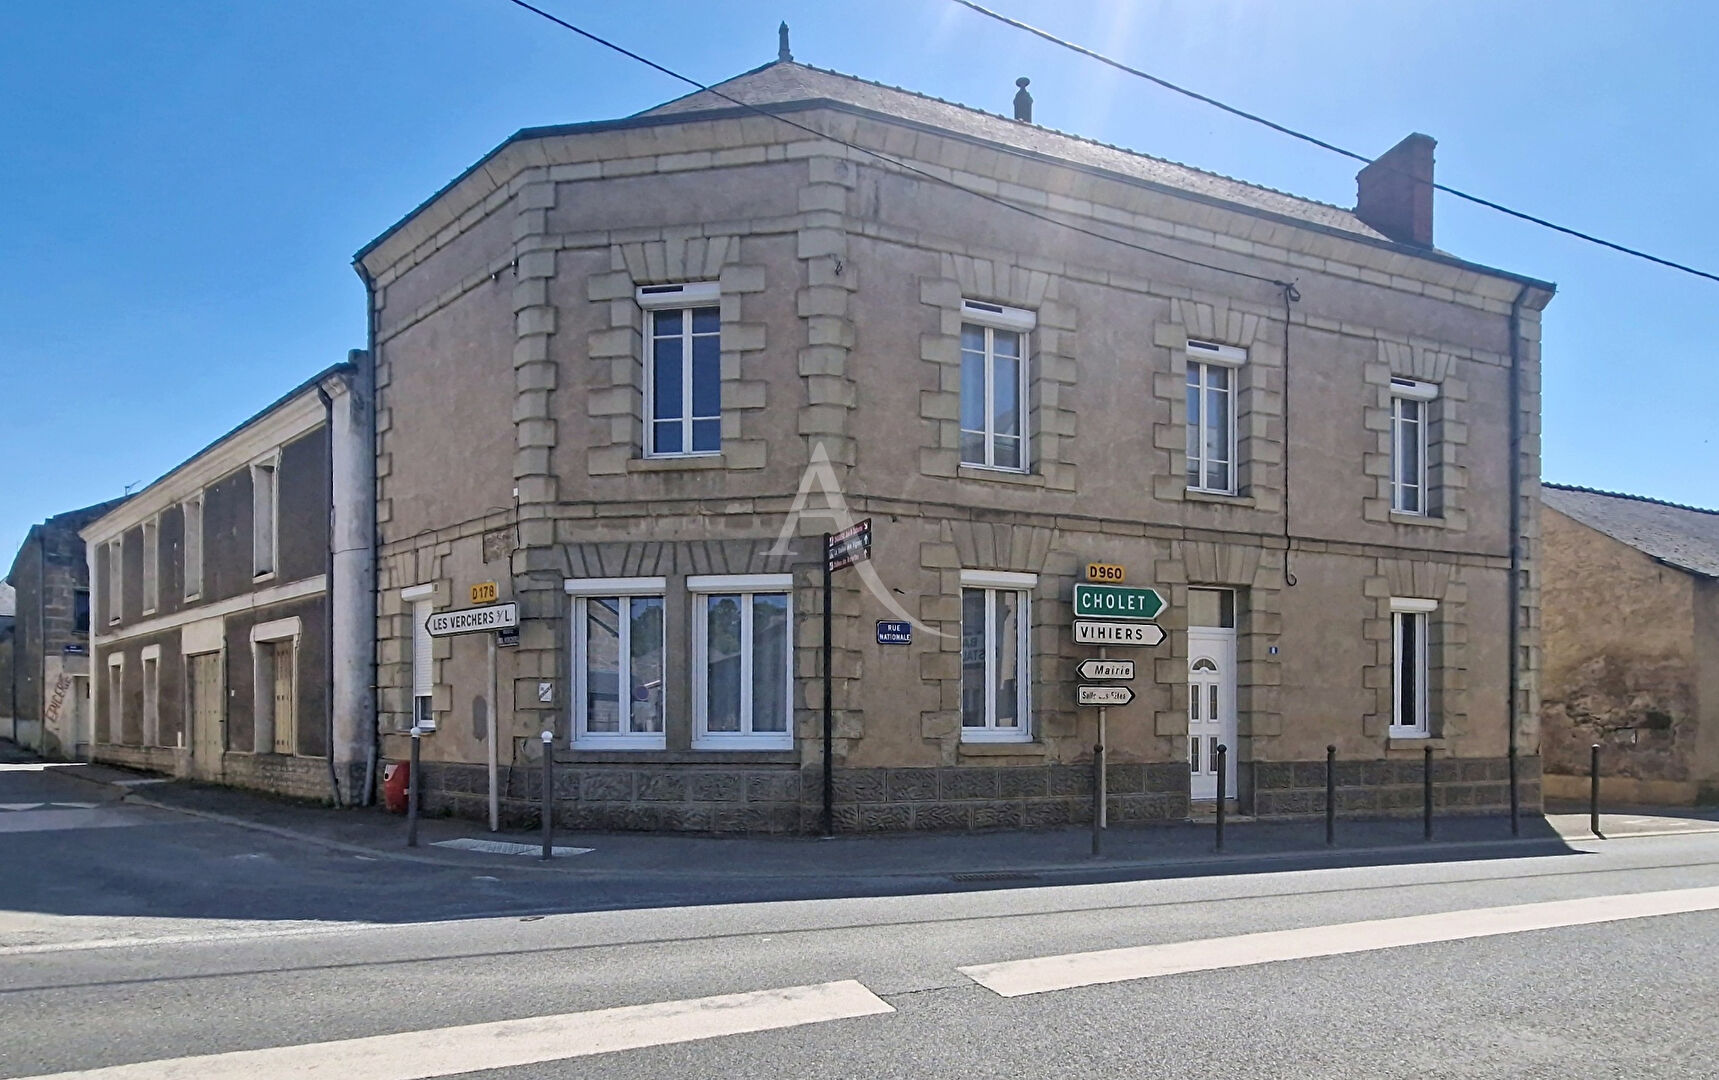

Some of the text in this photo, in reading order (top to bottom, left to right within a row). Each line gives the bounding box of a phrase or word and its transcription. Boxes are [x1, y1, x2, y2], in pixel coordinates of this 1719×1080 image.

[1089, 566, 1122, 579] D960
[472, 585, 494, 600] D178
[1082, 592, 1145, 611] CHOLET
[433, 618, 448, 631] LES
[450, 611, 494, 628] VERCHERS
[887, 624, 901, 632] RUE
[1080, 626, 1143, 640] VIHIERS
[879, 633, 911, 641] NATIONALE
[1094, 665, 1130, 675] Mairie
